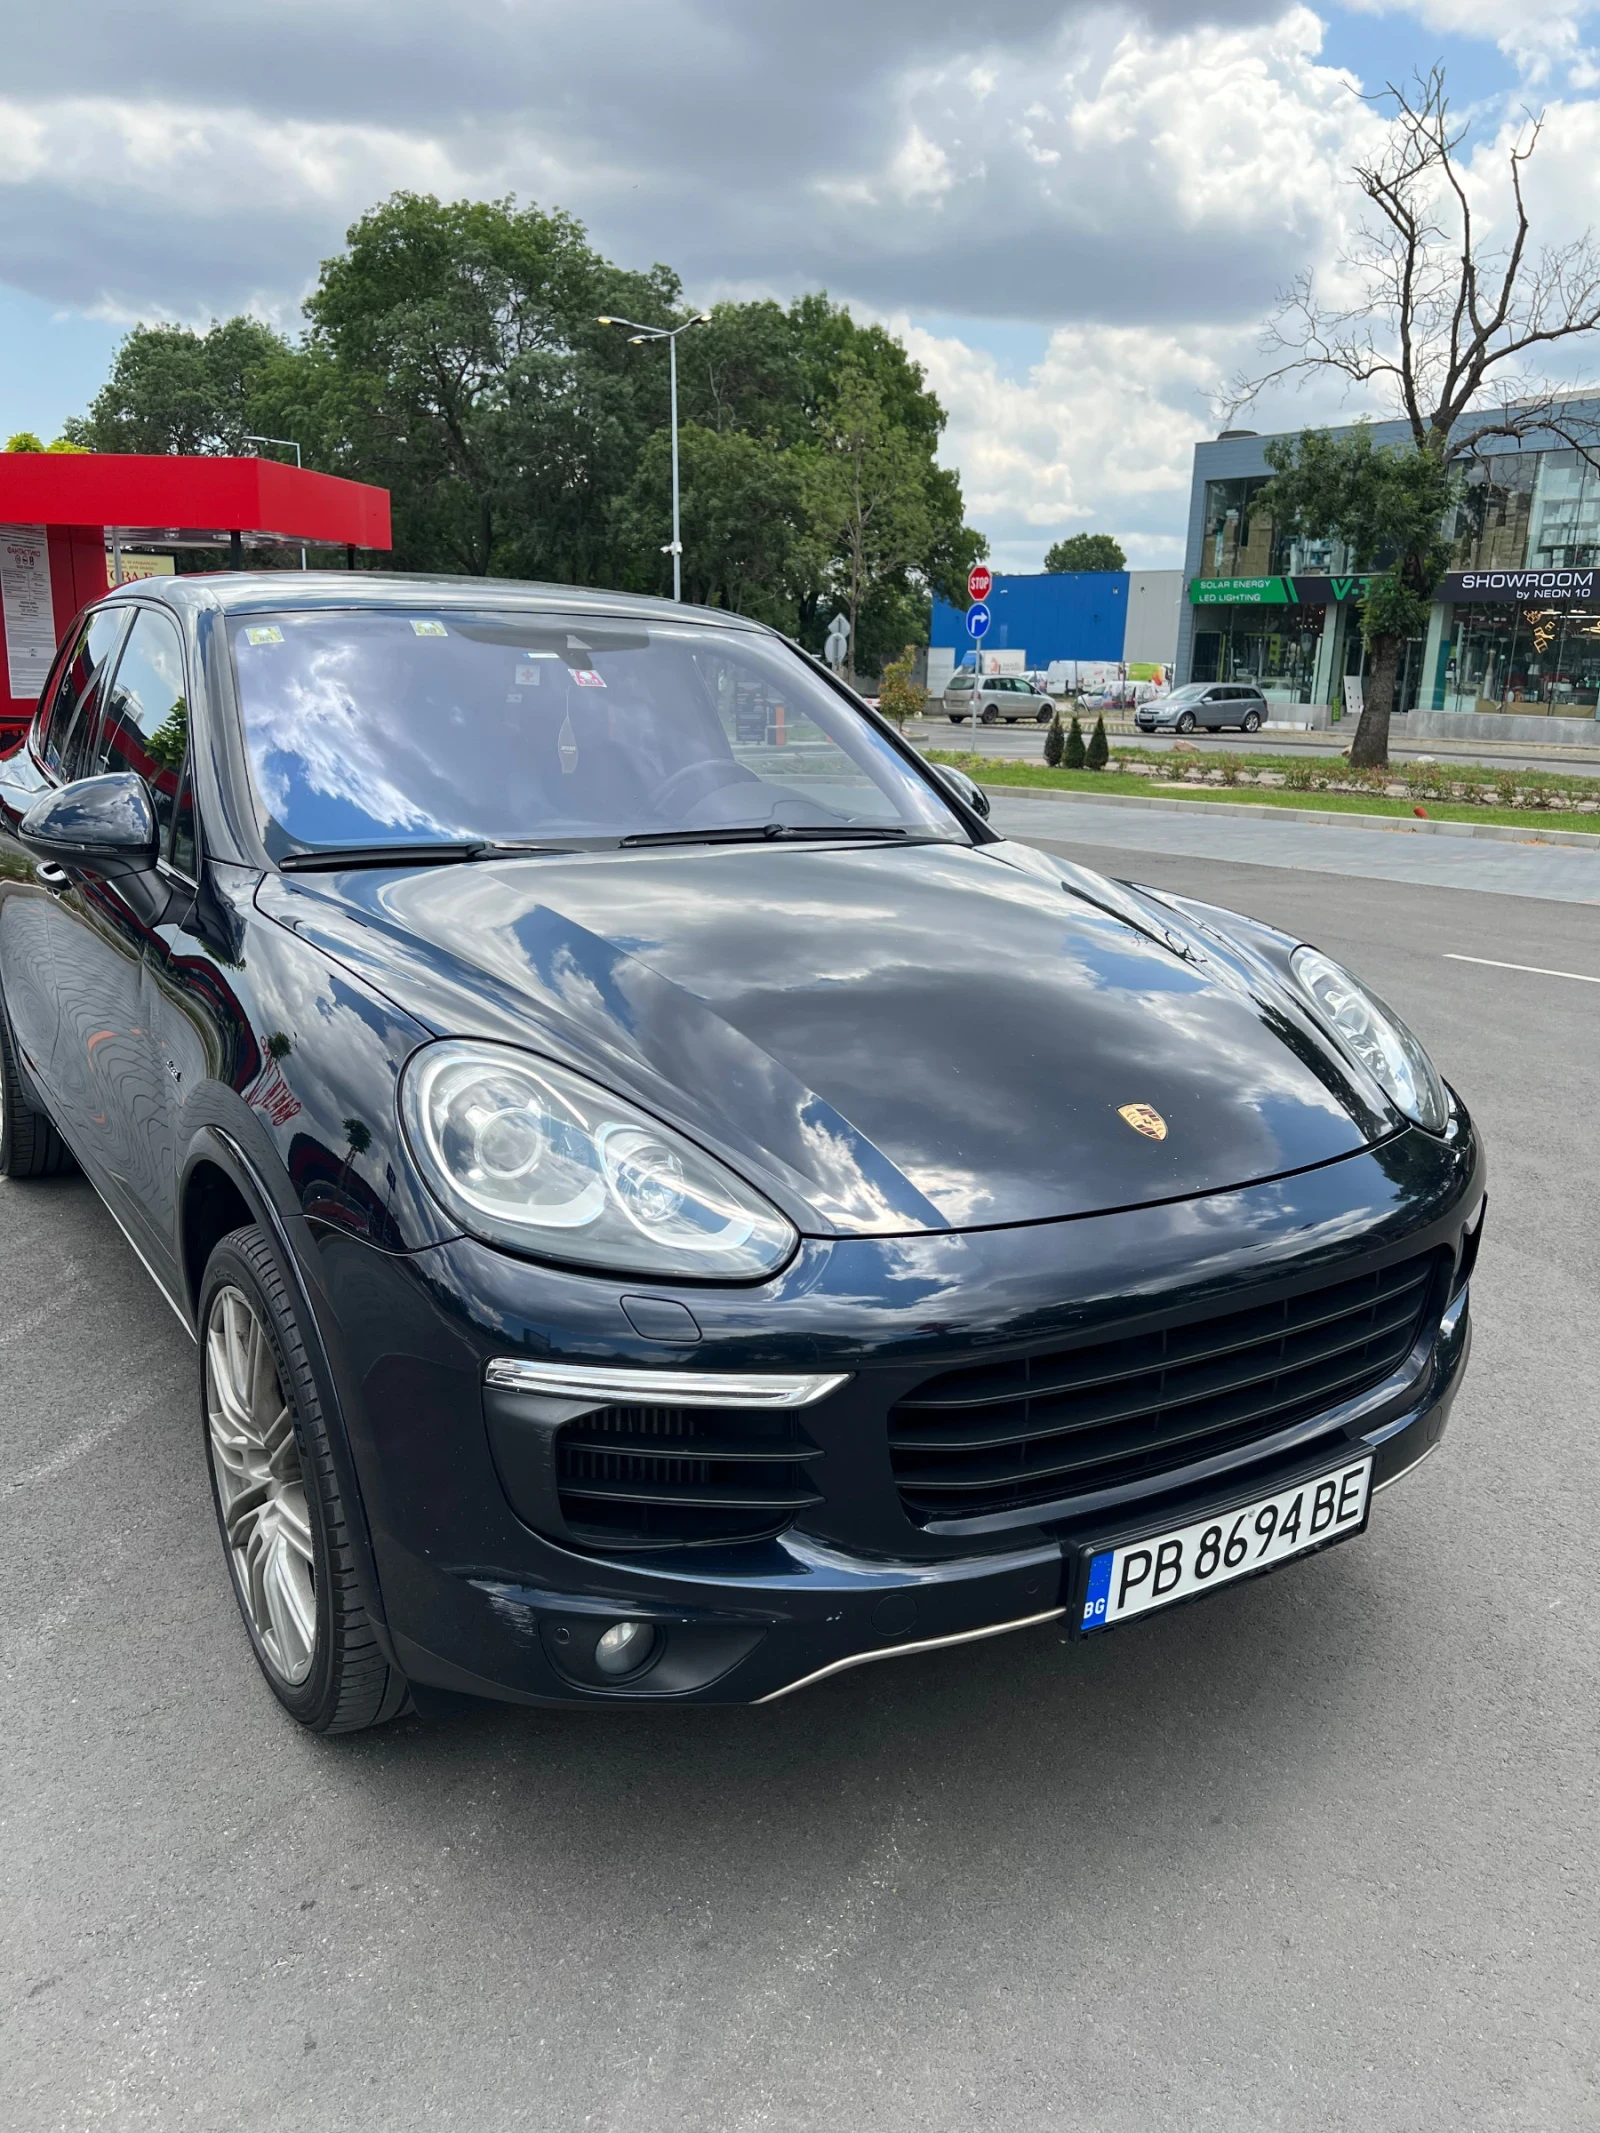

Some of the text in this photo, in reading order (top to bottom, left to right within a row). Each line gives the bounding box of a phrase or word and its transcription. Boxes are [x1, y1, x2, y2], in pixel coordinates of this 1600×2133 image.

[970, 576, 990, 590] STOP
[1200, 579, 1271, 589] SOLAR ENERGY
[1461, 572, 1594, 589] SHOWROOM
[1199, 593, 1261, 602] LED LIGHTING
[1516, 588, 1591, 600] by NEON 10
[1117, 1466, 1365, 1610] PB 8694 BE
[1083, 1597, 1106, 1619] BG
